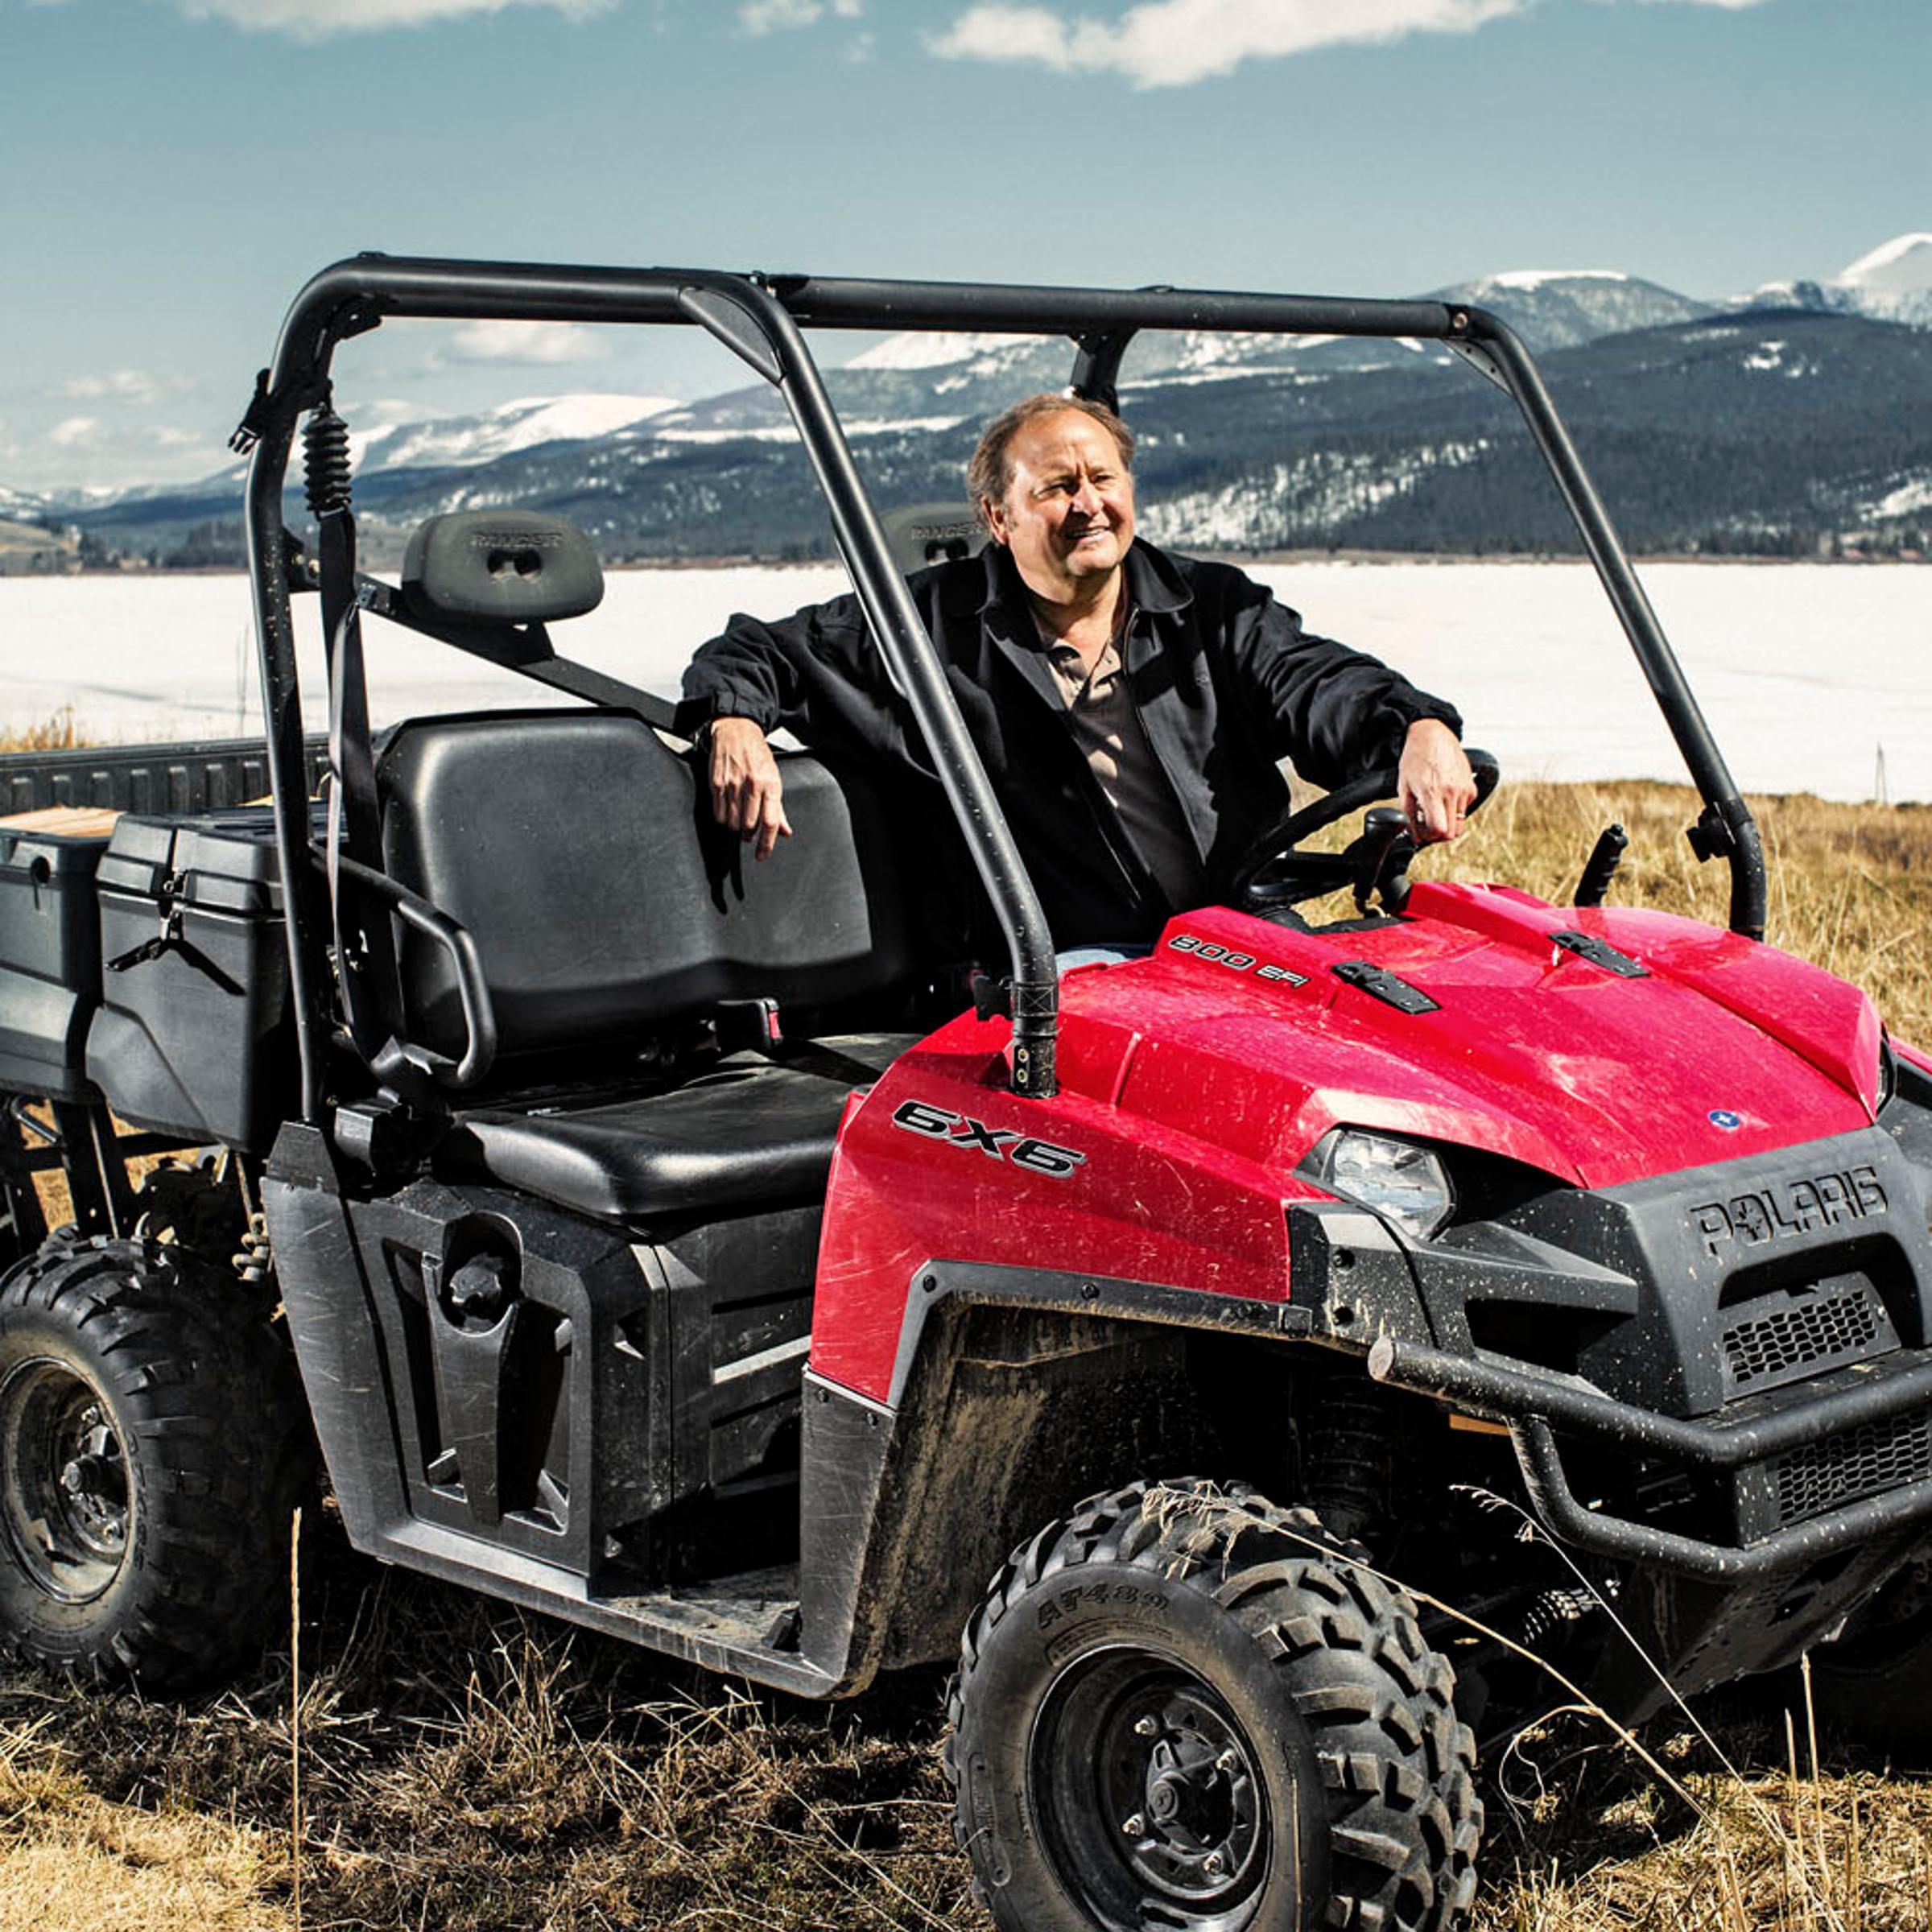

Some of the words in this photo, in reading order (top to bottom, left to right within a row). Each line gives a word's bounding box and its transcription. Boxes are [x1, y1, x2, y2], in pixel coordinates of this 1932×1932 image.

[1169, 935, 1256, 971] 800
[892, 1100, 1088, 1179] 6X6
[1689, 1165, 1889, 1257] POLARIS
